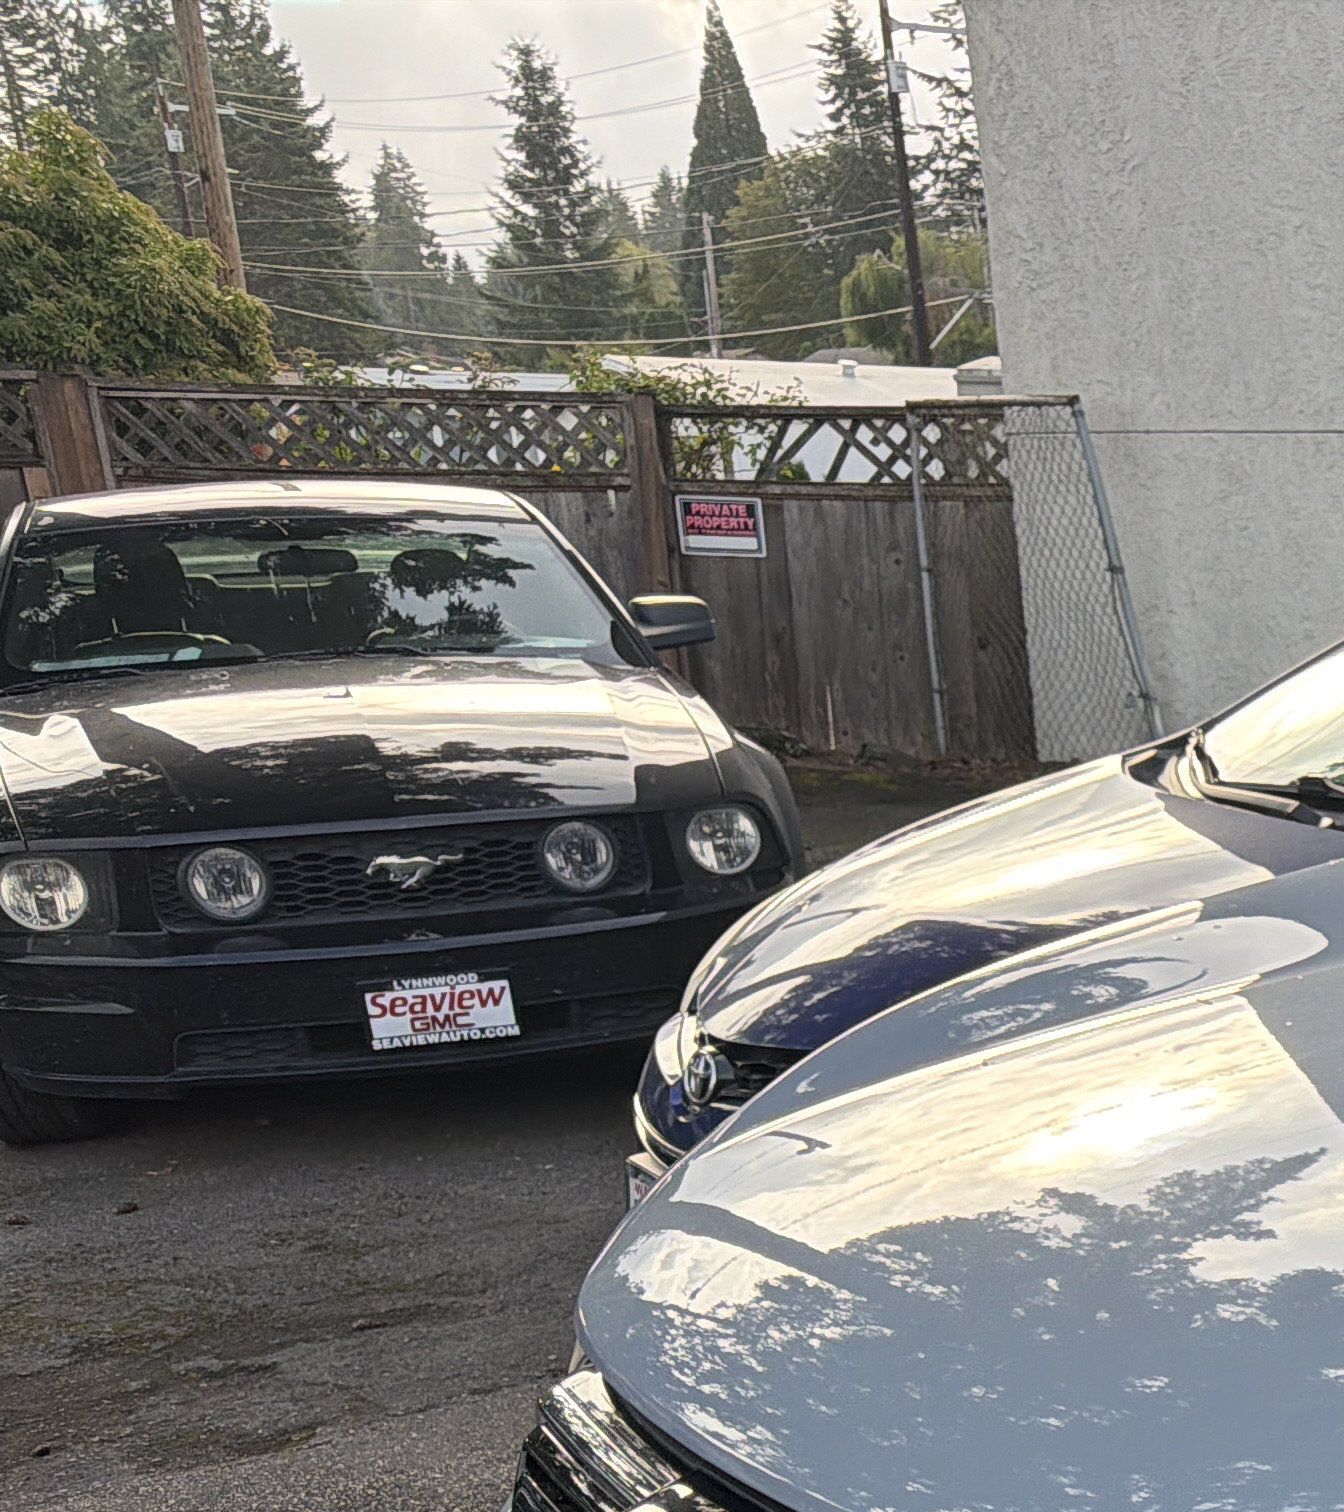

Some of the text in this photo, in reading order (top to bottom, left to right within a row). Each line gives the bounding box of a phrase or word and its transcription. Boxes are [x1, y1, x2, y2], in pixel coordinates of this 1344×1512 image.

[691, 503, 747, 517] PRIVATE
[686, 515, 755, 530] PROPERTY
[392, 972, 478, 991] LYNNWOOD
[369, 984, 507, 1019] Seaview
[410, 1011, 476, 1033] GMC
[372, 1024, 520, 1050] SEAVIEWAUTO.COM
